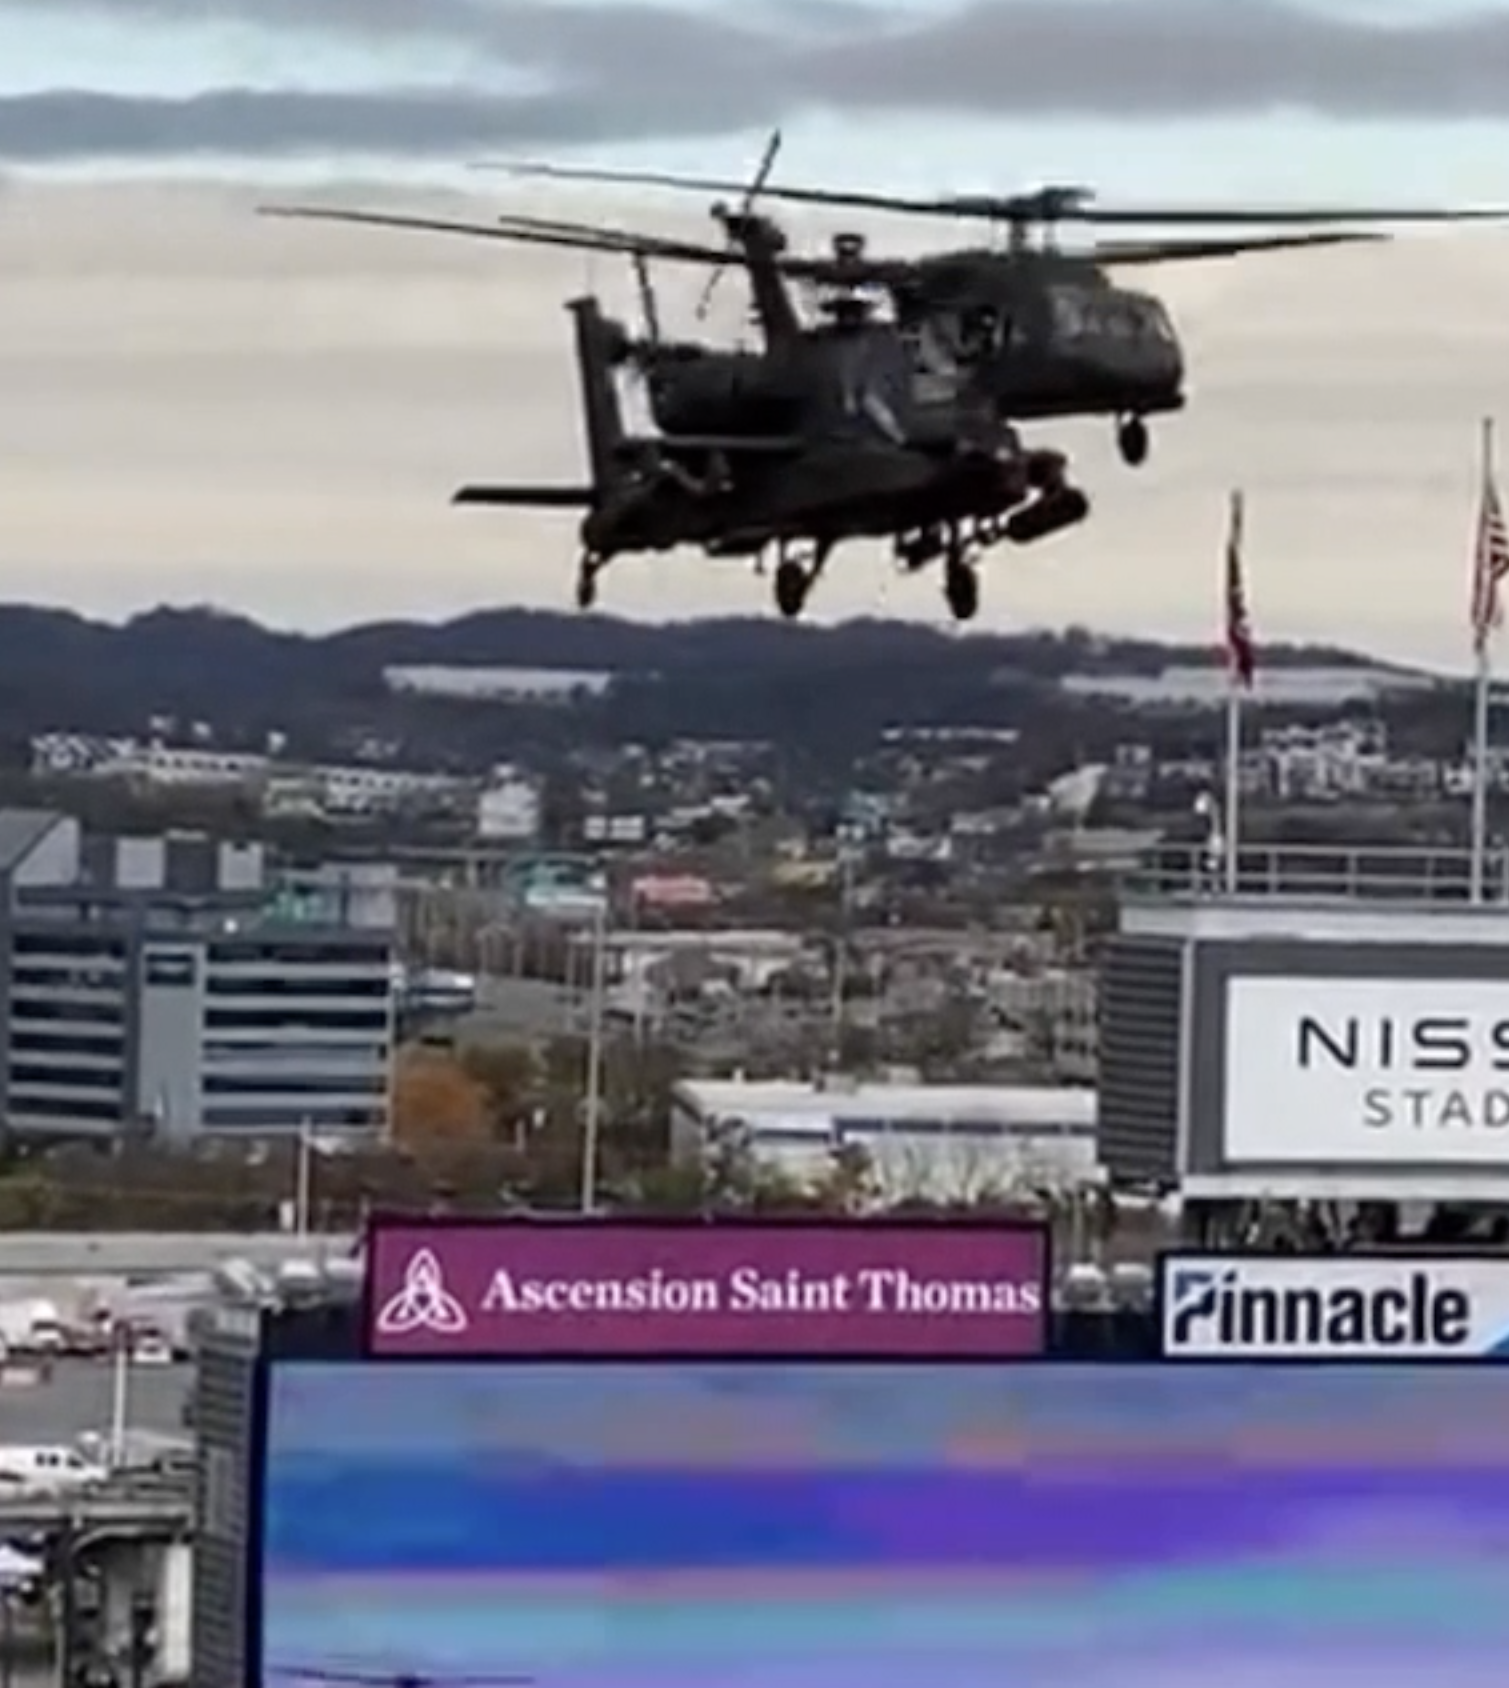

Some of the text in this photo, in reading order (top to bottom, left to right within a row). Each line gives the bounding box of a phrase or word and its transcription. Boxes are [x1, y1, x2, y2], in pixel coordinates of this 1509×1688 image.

[481, 1268, 1042, 1314] Ascension Saint Thomas
[1172, 1270, 1471, 1347] Pinnacle
